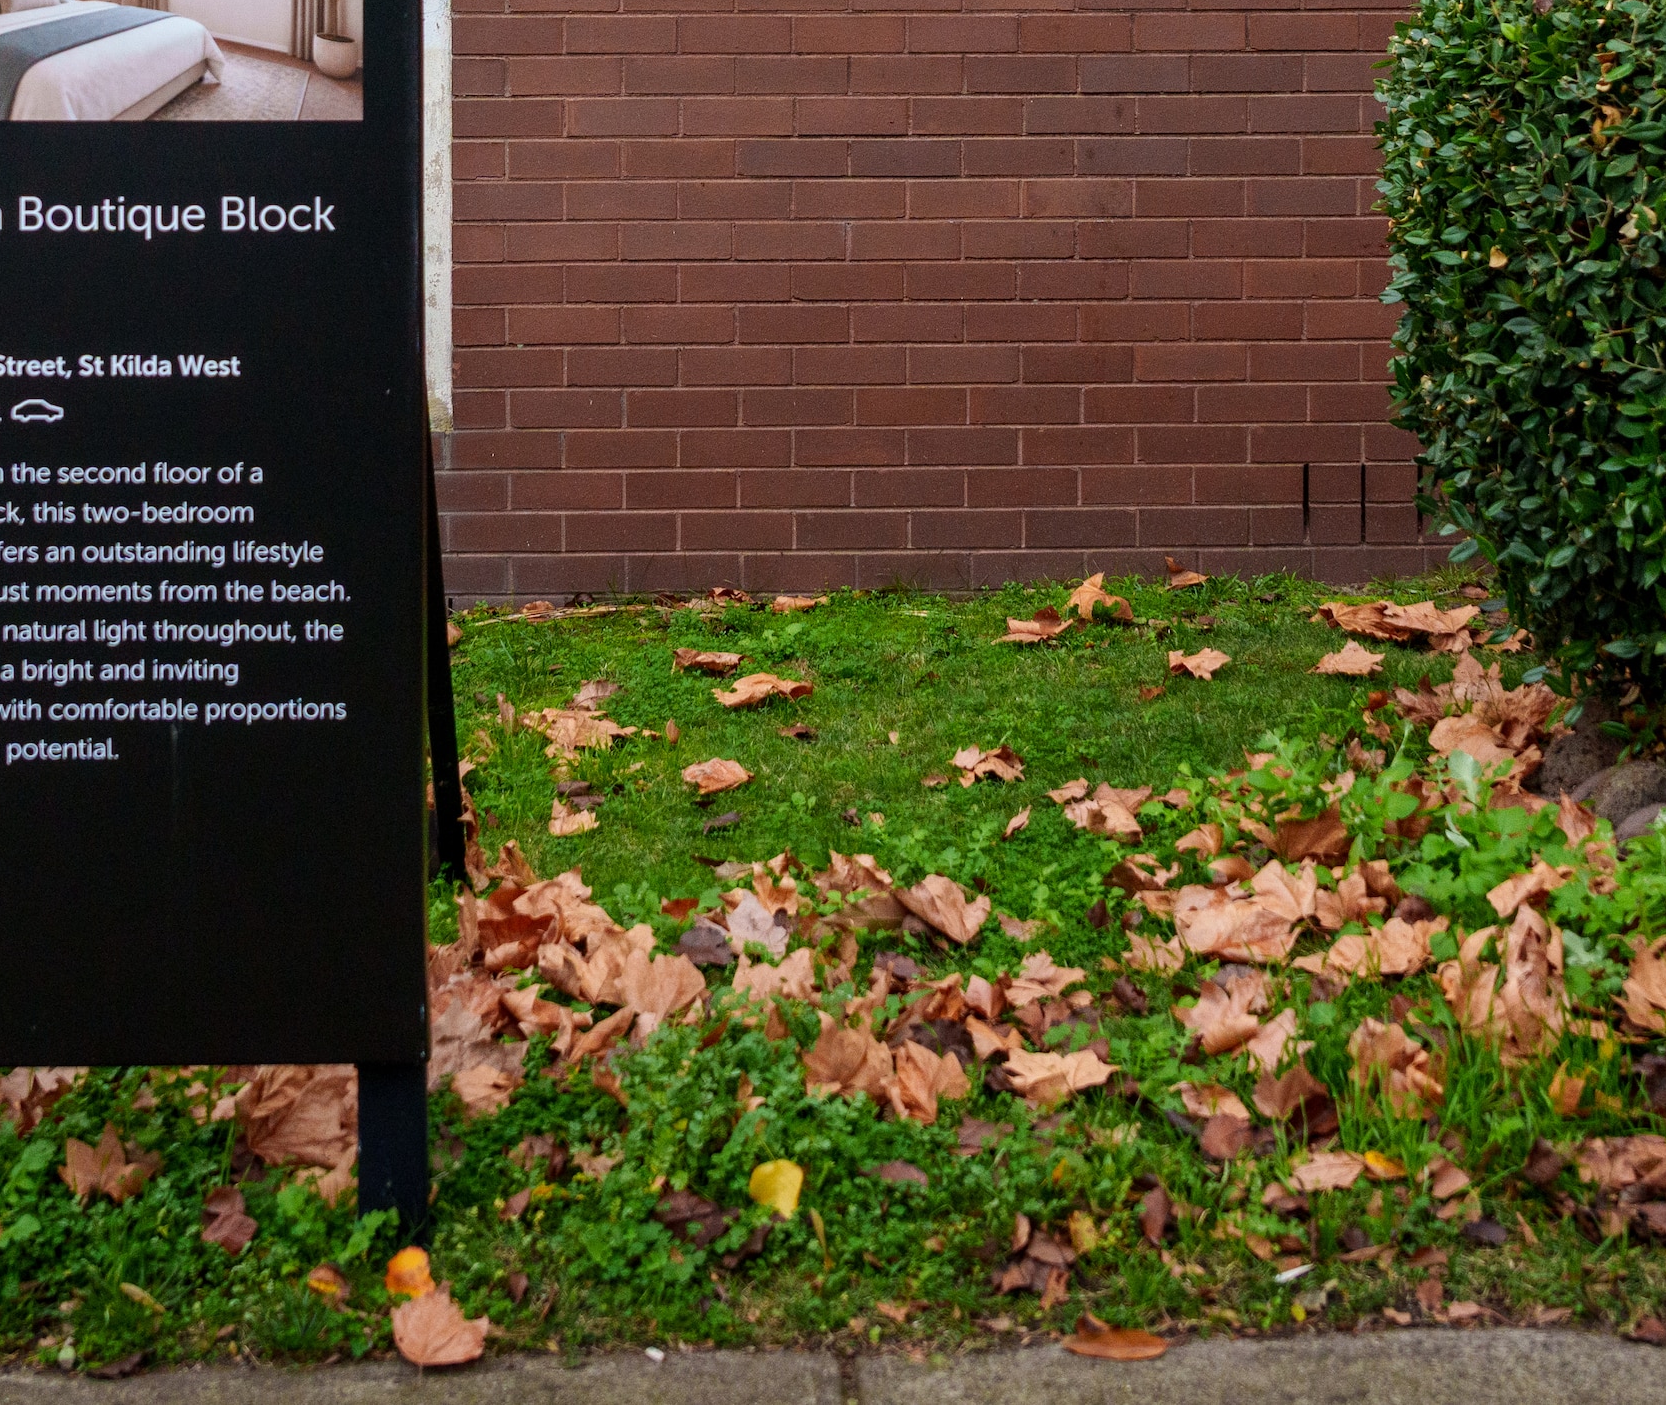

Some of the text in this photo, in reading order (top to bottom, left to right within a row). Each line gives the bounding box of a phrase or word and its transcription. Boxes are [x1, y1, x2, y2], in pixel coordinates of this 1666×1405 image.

[18, 195, 206, 241] Boutique
[220, 195, 336, 233] Block
[78, 354, 105, 378] St
[110, 354, 173, 378] Kilda
[177, 354, 241, 378] West
[10, 461, 52, 485] the
[56, 461, 147, 485] second
[152, 461, 212, 485] floor
[216, 461, 245, 485] of
[248, 466, 264, 485] a
[31, 500, 77, 524] this
[81, 500, 255, 524] two-bedroom
[44, 545, 76, 563] an
[81, 540, 226, 569] outstanding
[232, 540, 325, 568] lifestyle
[35, 581, 153, 603] moments
[158, 579, 218, 603] from
[223, 579, 265, 603] the
[270, 579, 351, 603] beach.
[2, 618, 88, 642] natural
[93, 618, 148, 648] light
[152, 618, 297, 647] throughout,
[304, 618, 345, 642] the
[0, 663, 15, 682] a
[21, 658, 95, 687] bright
[99, 658, 146, 682] and
[152, 658, 239, 687] inviting
[47, 697, 199, 721] comfortable
[204, 697, 347, 726] proportions
[5, 737, 120, 766] potential.
